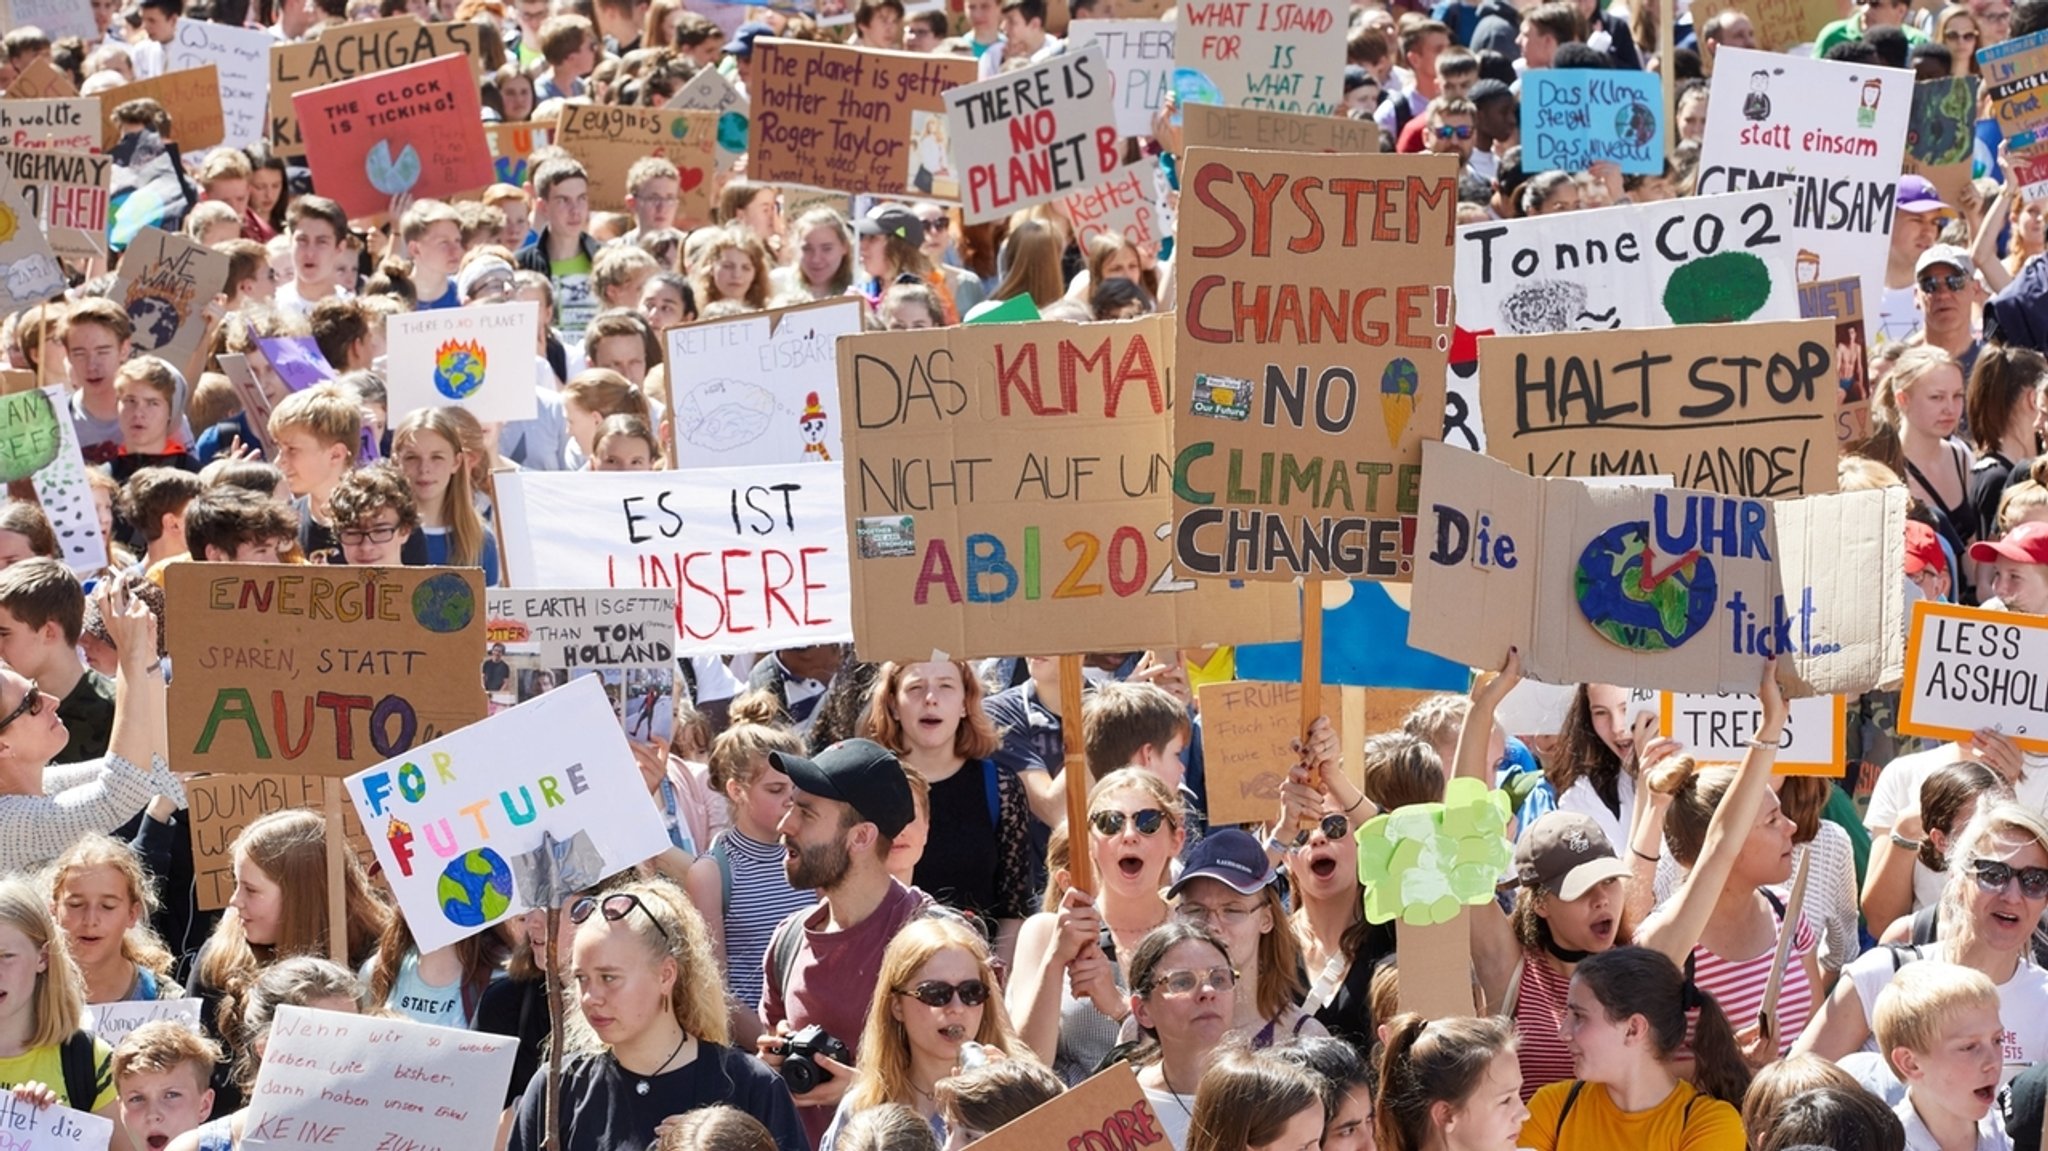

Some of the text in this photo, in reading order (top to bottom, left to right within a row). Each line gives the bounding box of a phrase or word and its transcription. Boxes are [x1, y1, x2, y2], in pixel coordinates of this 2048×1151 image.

[1187, 2, 1334, 35] WHAT I STAND
[278, 23, 472, 82] LACHGAS
[756, 44, 797, 77] The
[804, 51, 864, 87] planet
[872, 58, 890, 90] is
[1202, 34, 1241, 61] FOR
[1269, 44, 1296, 69] IS
[324, 80, 441, 119] THE CLOCK
[761, 81, 827, 114] hotter
[838, 89, 891, 123] than
[954, 56, 1094, 130] THERE IS
[1246, 71, 1324, 99] WHAT I
[331, 120, 352, 135] IS
[366, 92, 456, 127] TICKING!
[757, 111, 903, 158] Roger Taylor
[1008, 109, 1057, 154] NO
[1739, 123, 1878, 158] statt einsam
[967, 125, 1119, 214] PLANET B
[1192, 162, 1456, 259] SYSTEM
[159, 236, 207, 279] WE
[1463, 225, 1640, 283] Tonne
[1185, 274, 1452, 352] CHANGE!
[854, 333, 1165, 429] DAS KLIMA
[1262, 364, 1359, 435] NO
[1514, 350, 1673, 432] HALT
[1680, 340, 1831, 419] STOP
[0, 389, 58, 430] ANT
[858, 457, 993, 513] NICHT
[1014, 452, 1101, 500] AUF
[1171, 441, 1422, 513] CLIMATE
[623, 483, 802, 544] ES IST
[1431, 493, 1773, 571] Die UHR
[1176, 508, 1418, 577] CHANGE!
[914, 526, 1041, 606] ABI
[209, 573, 403, 623] ENERGIE
[488, 599, 514, 617] HE
[525, 596, 587, 617] EARTH
[536, 626, 582, 641] THAN
[593, 622, 645, 643] TOM
[564, 641, 672, 668] HOLLAND
[1936, 619, 2021, 661] LESS
[199, 646, 427, 681] SPAREN, STATT
[193, 687, 418, 761] AUTO
[1683, 710, 1794, 750] TRES
[362, 750, 457, 818] FOR
[386, 762, 590, 878] FUTURE
[275, 1009, 349, 1038] Wenn
[369, 1026, 404, 1043] wir
[427, 1035, 442, 1047] so
[329, 1060, 365, 1074] wie
[261, 1079, 305, 1097] dann
[320, 1087, 370, 1107] haben
[384, 1099, 424, 1114] unsere
[51, 1115, 83, 1143] die
[254, 1111, 346, 1144] KEINE
